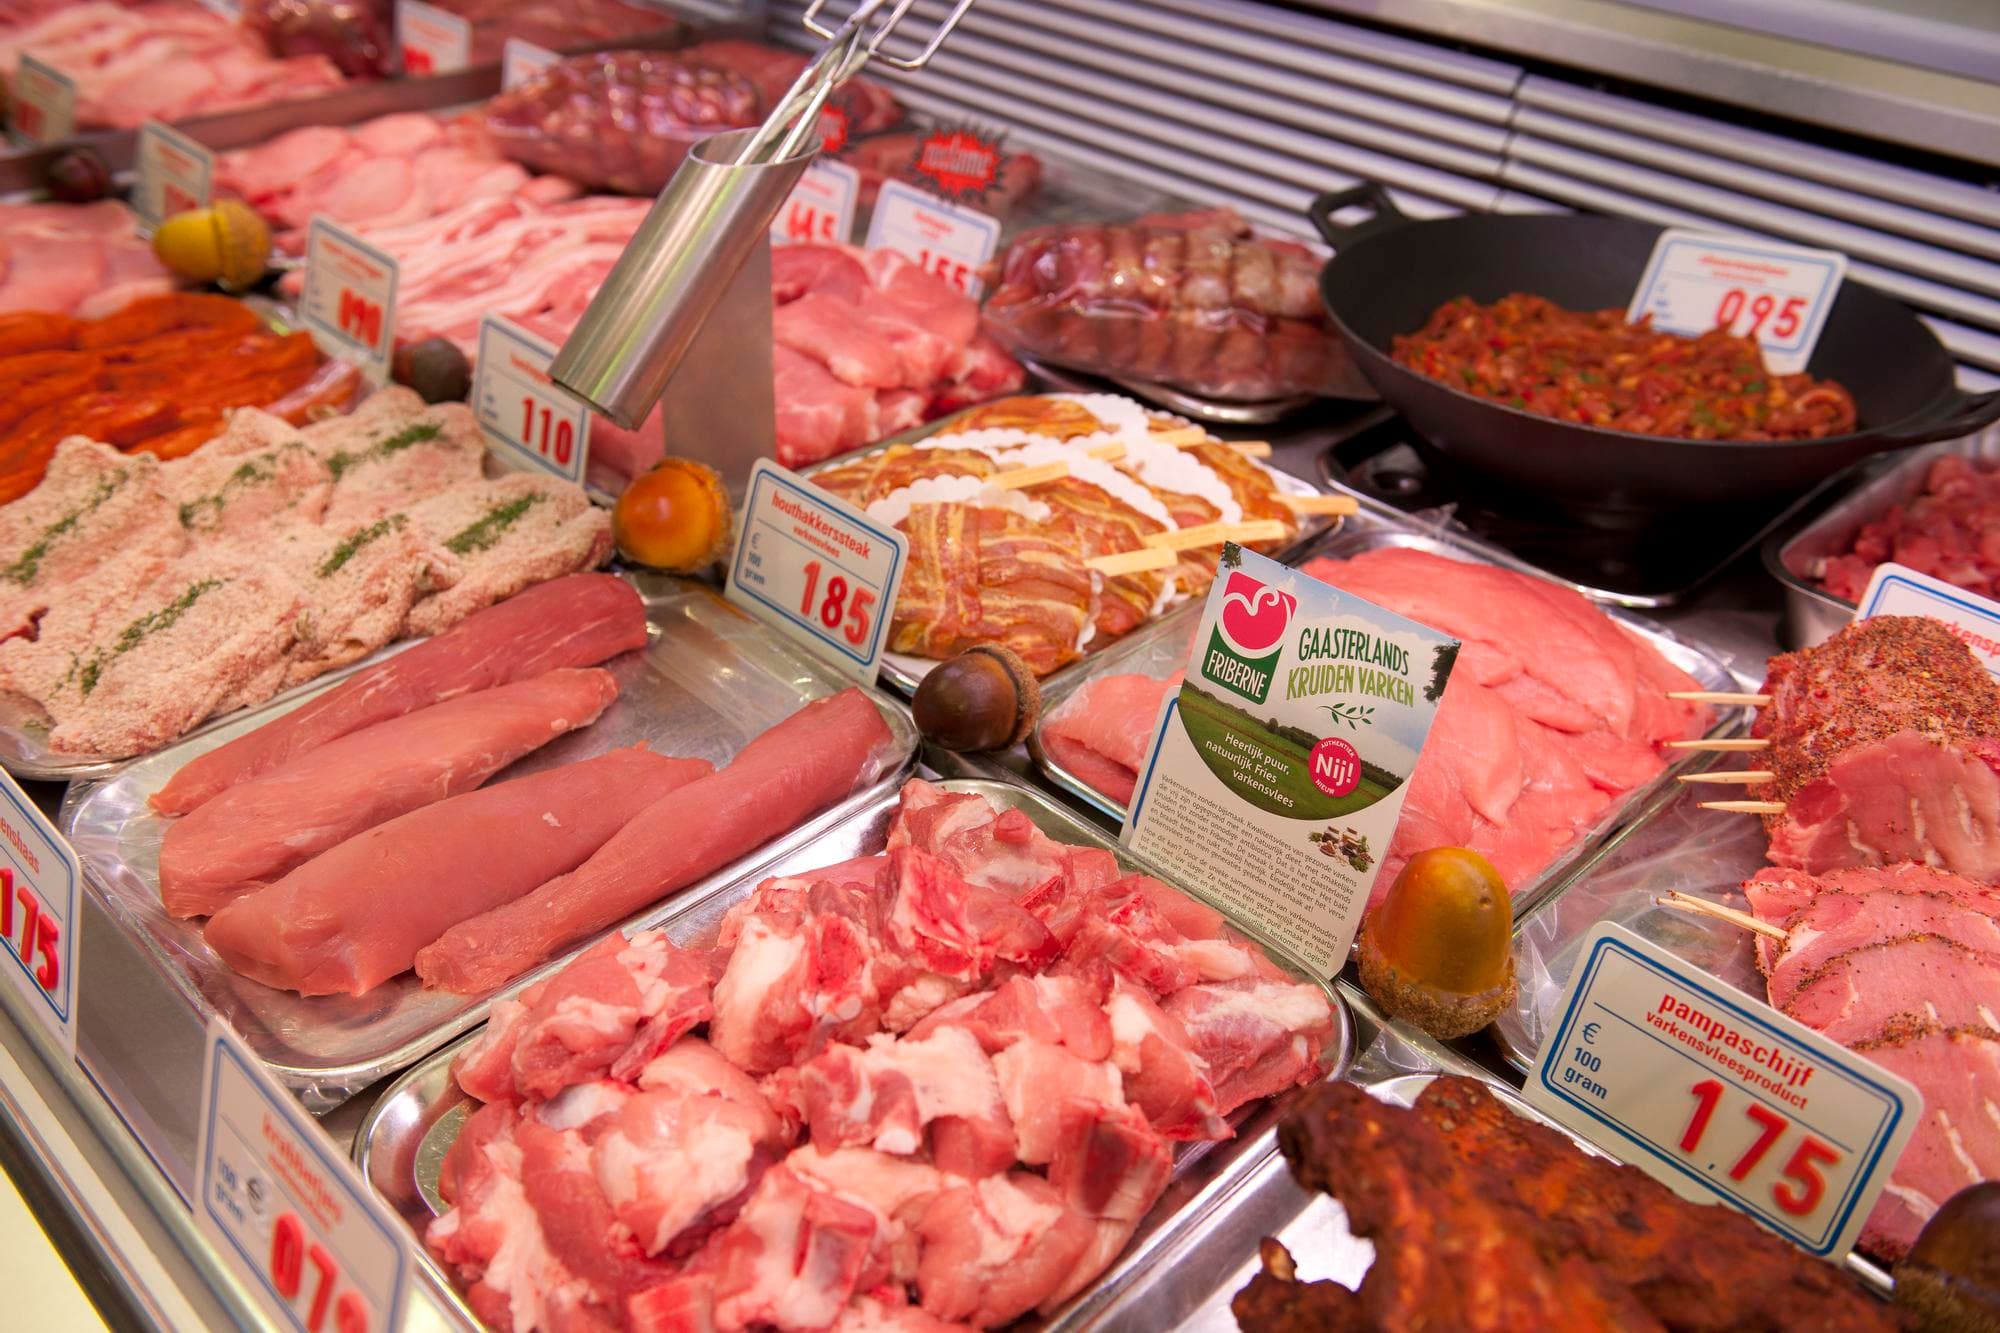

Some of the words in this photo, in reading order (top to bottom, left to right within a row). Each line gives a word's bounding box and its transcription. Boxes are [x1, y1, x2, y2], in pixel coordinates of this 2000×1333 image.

[523, 397, 574, 466] 110
[771, 491, 871, 559] houthakkerssteak
[1206, 649, 1268, 699] FRIBERNE
[1286, 663, 1354, 701] KRUIDEN
[1357, 665, 1416, 708] VARKEN
[1298, 627, 1410, 677] GAASTERLANDS
[1205, 740, 1253, 772] natuurlijk
[1253, 764, 1277, 784] Fries
[1224, 731, 1270, 766] Heerlijk
[1263, 753, 1290, 777] puur,
[1315, 752, 1354, 786] Nij!
[1232, 769, 1295, 809] varkensvlees
[0, 817, 41, 876] enshaas
[1148, 815, 1183, 838] varkensvlees
[1209, 851, 1241, 872] generaties
[1241, 869, 1266, 886] geleden
[1282, 892, 1303, 907] smaak
[1155, 790, 1177, 807] kruiden
[1188, 810, 1208, 824] zonder
[1210, 822, 1238, 841] onnodige
[1310, 876, 1351, 904] Gaasterlands
[1176, 811, 1196, 827] Varken
[1247, 853, 1268, 867] smaak
[1274, 868, 1290, 879] puur
[1333, 900, 1348, 912] bakt
[1179, 823, 1195, 836] beter
[1206, 839, 1220, 850] ruikt
[1221, 847, 1242, 865] daarbij
[1269, 874, 1295, 893] Eindelijk
[1296, 890, 1313, 903] weer
[1327, 908, 1345, 921] verse
[1180, 796, 1190, 805] zijn
[1192, 802, 1225, 823] opgegroeid
[1254, 837, 1283, 856] natuurlijk
[1320, 873, 1354, 895] smakelijke
[1197, 796, 1217, 810] zonder
[1246, 821, 1292, 850] Kwaliteitsvlees
[1303, 854, 1332, 873] gezonde
[1332, 870, 1357, 887] varkens
[1182, 869, 1199, 882] mens
[1208, 883, 1221, 895] dier
[1222, 892, 1247, 910] centraal
[1265, 918, 1281, 930] pure
[1282, 928, 1303, 943] smaak
[1314, 945, 1331, 959] hoge
[1183, 849, 1198, 862] Door
[1229, 877, 1273, 907] samenwerking
[1288, 911, 1338, 942] varkenshouders
[1217, 878, 1240, 896] hebben
[1255, 902, 1294, 927] gezamenlijk
[1294, 923, 1309, 936] doel
[1310, 934, 1335, 953] waarbij
[1573, 1046, 1601, 1073] 100
[1581, 1021, 1602, 1045] €
[1646, 1008, 1808, 1112] varkensvleesproduct
[1657, 993, 1815, 1089] pampaschijf
[1563, 1065, 1608, 1100] gram
